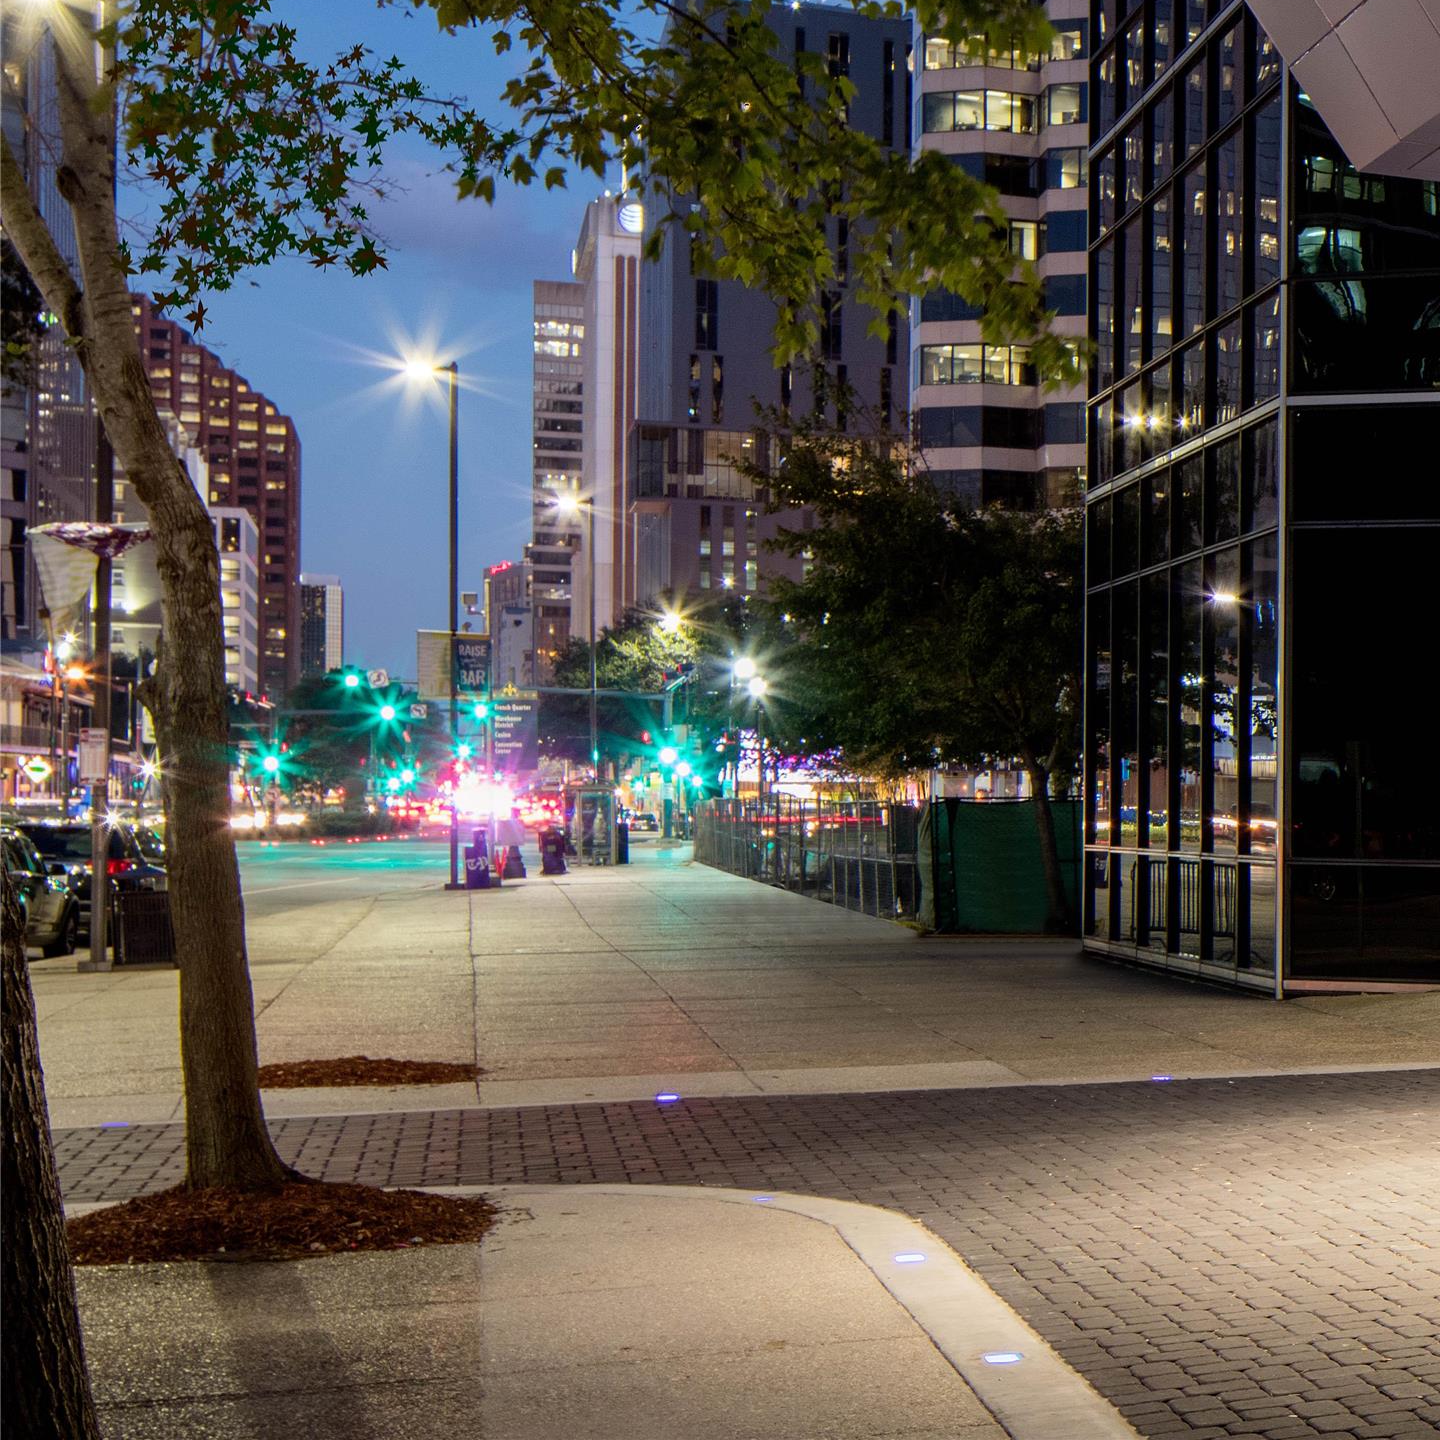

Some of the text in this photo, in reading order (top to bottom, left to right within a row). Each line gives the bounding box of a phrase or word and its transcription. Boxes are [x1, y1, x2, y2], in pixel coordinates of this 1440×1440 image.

[459, 644, 487, 657] RAISE
[461, 669, 486, 685] BAR
[512, 703, 531, 712] Quarter
